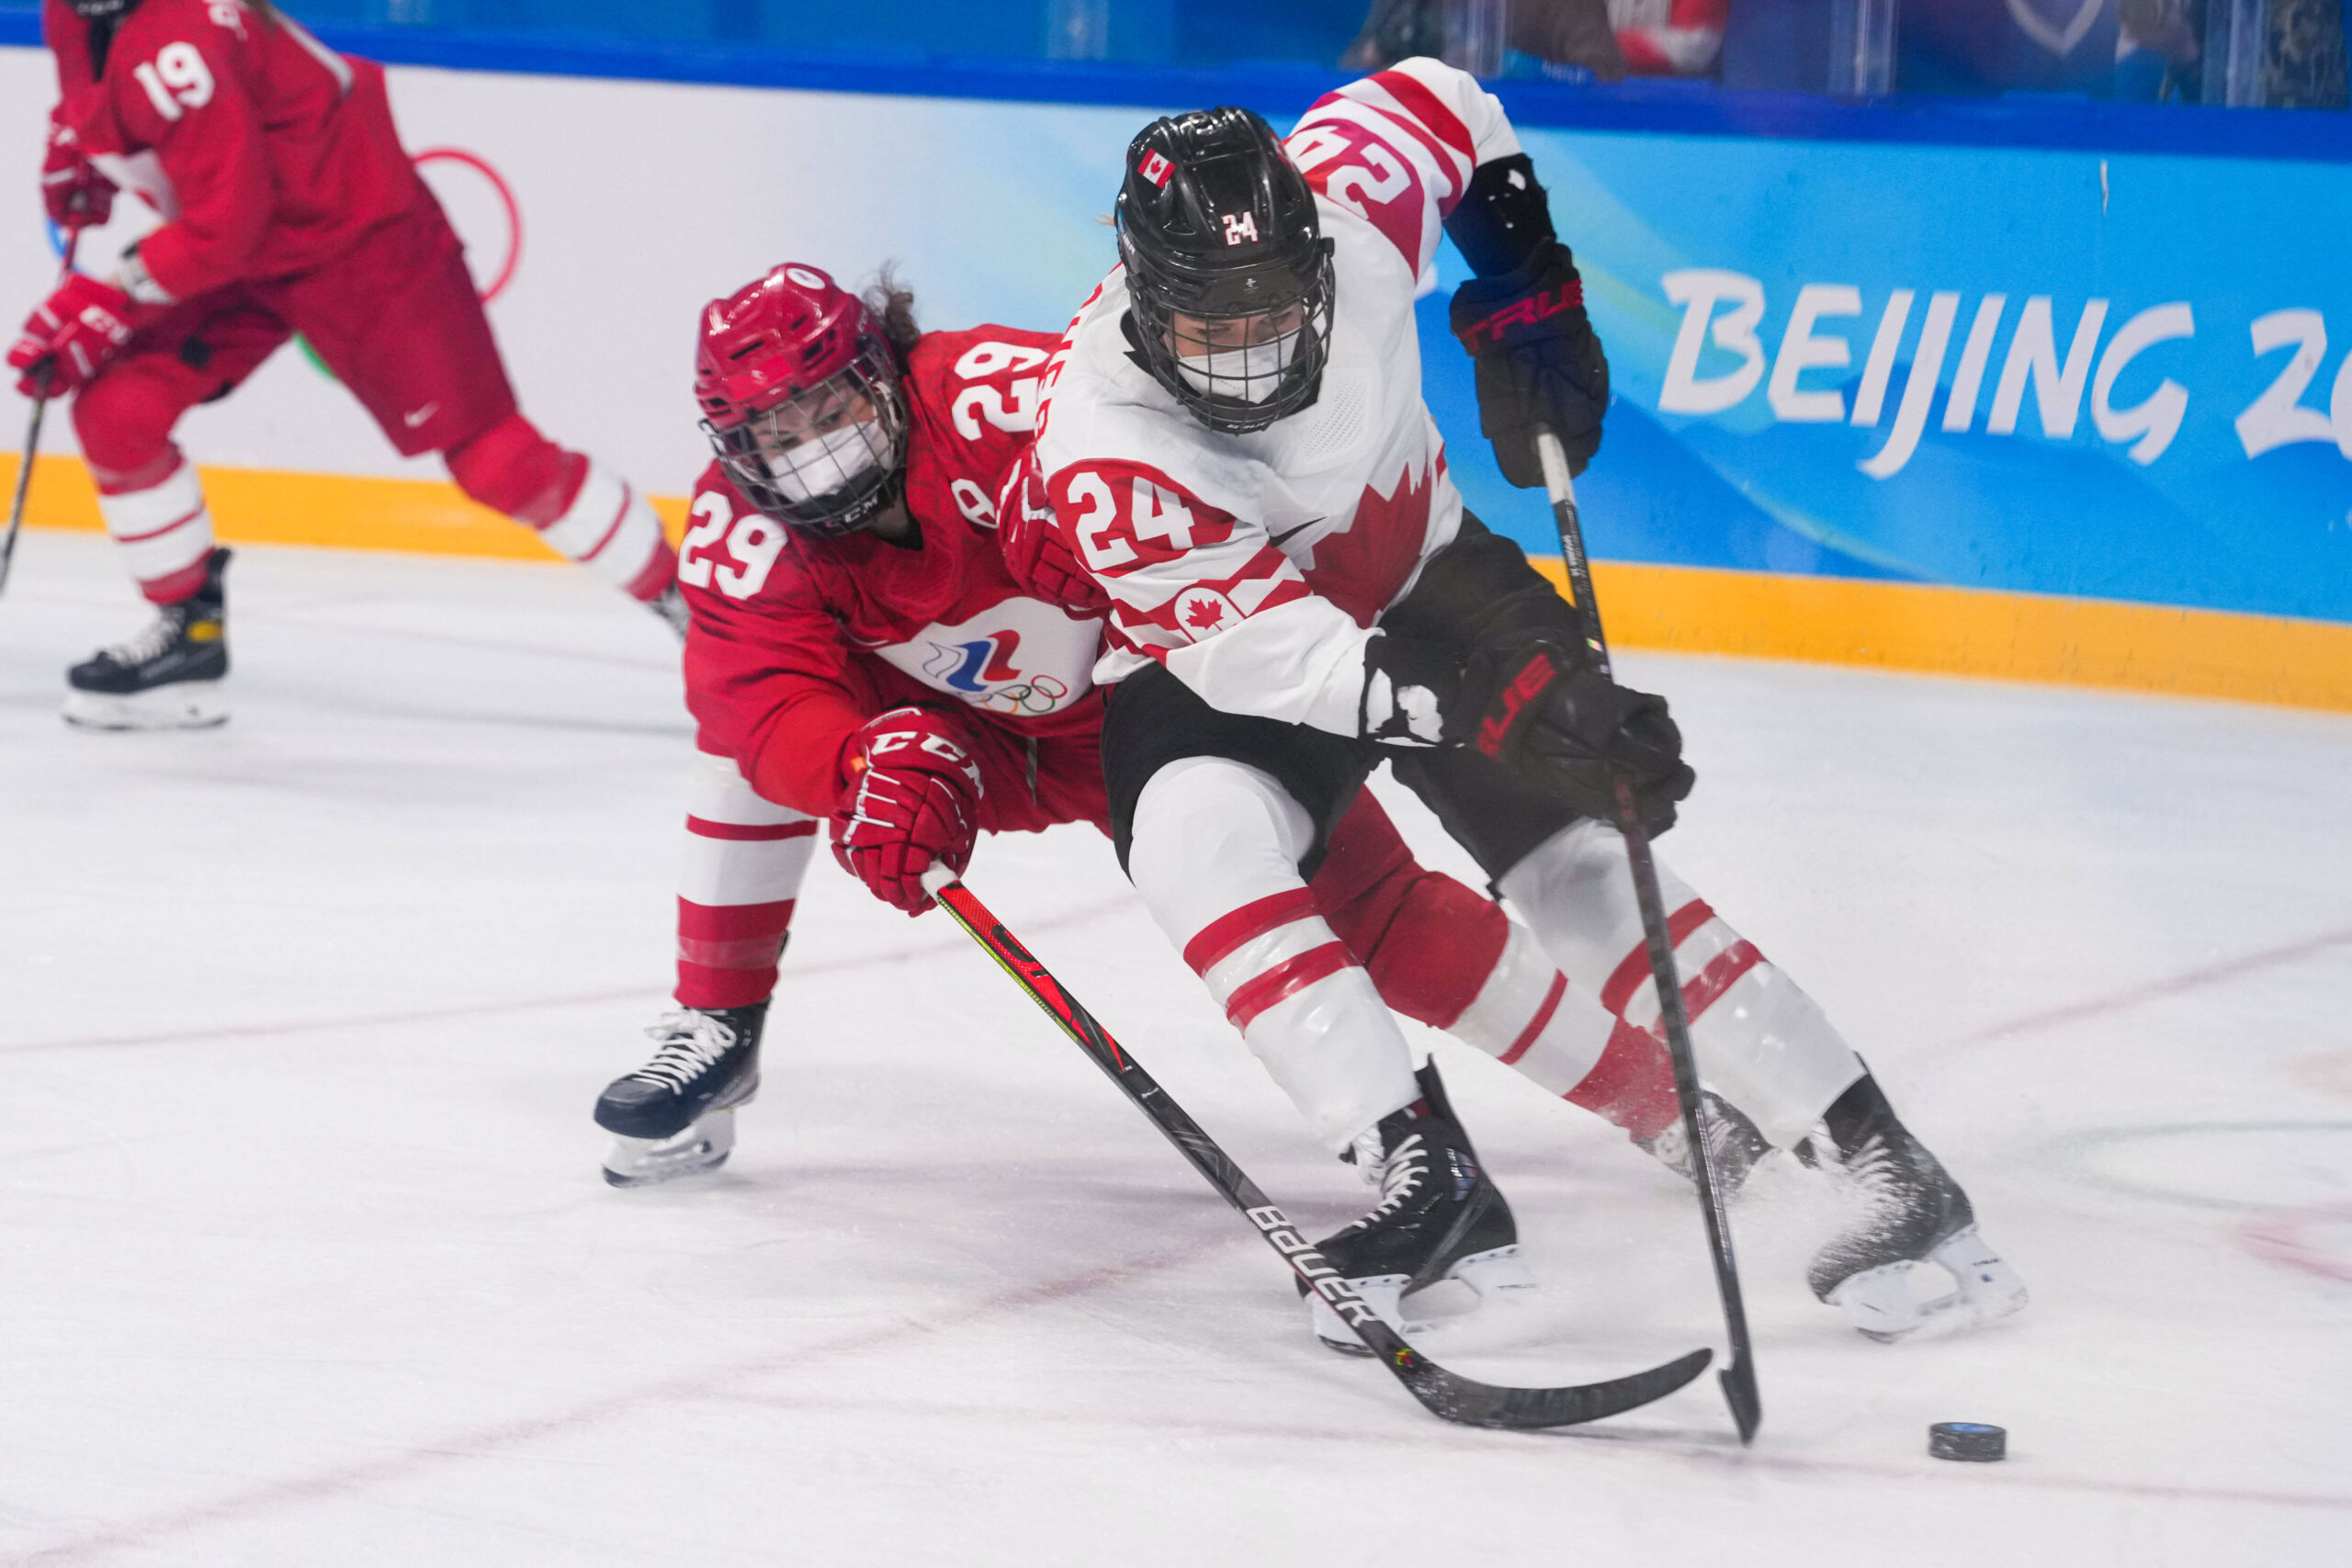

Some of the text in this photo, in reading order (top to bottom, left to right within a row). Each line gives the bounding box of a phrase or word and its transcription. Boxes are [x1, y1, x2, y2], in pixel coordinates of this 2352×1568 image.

[133, 40, 215, 122] 19
[1221, 211, 1259, 246] 24
[1458, 278, 1584, 352] TRUE
[952, 341, 1050, 441] 29
[1657, 267, 2352, 480] BEIJING 2
[678, 490, 788, 600] 29
[1067, 471, 1195, 571] 24
